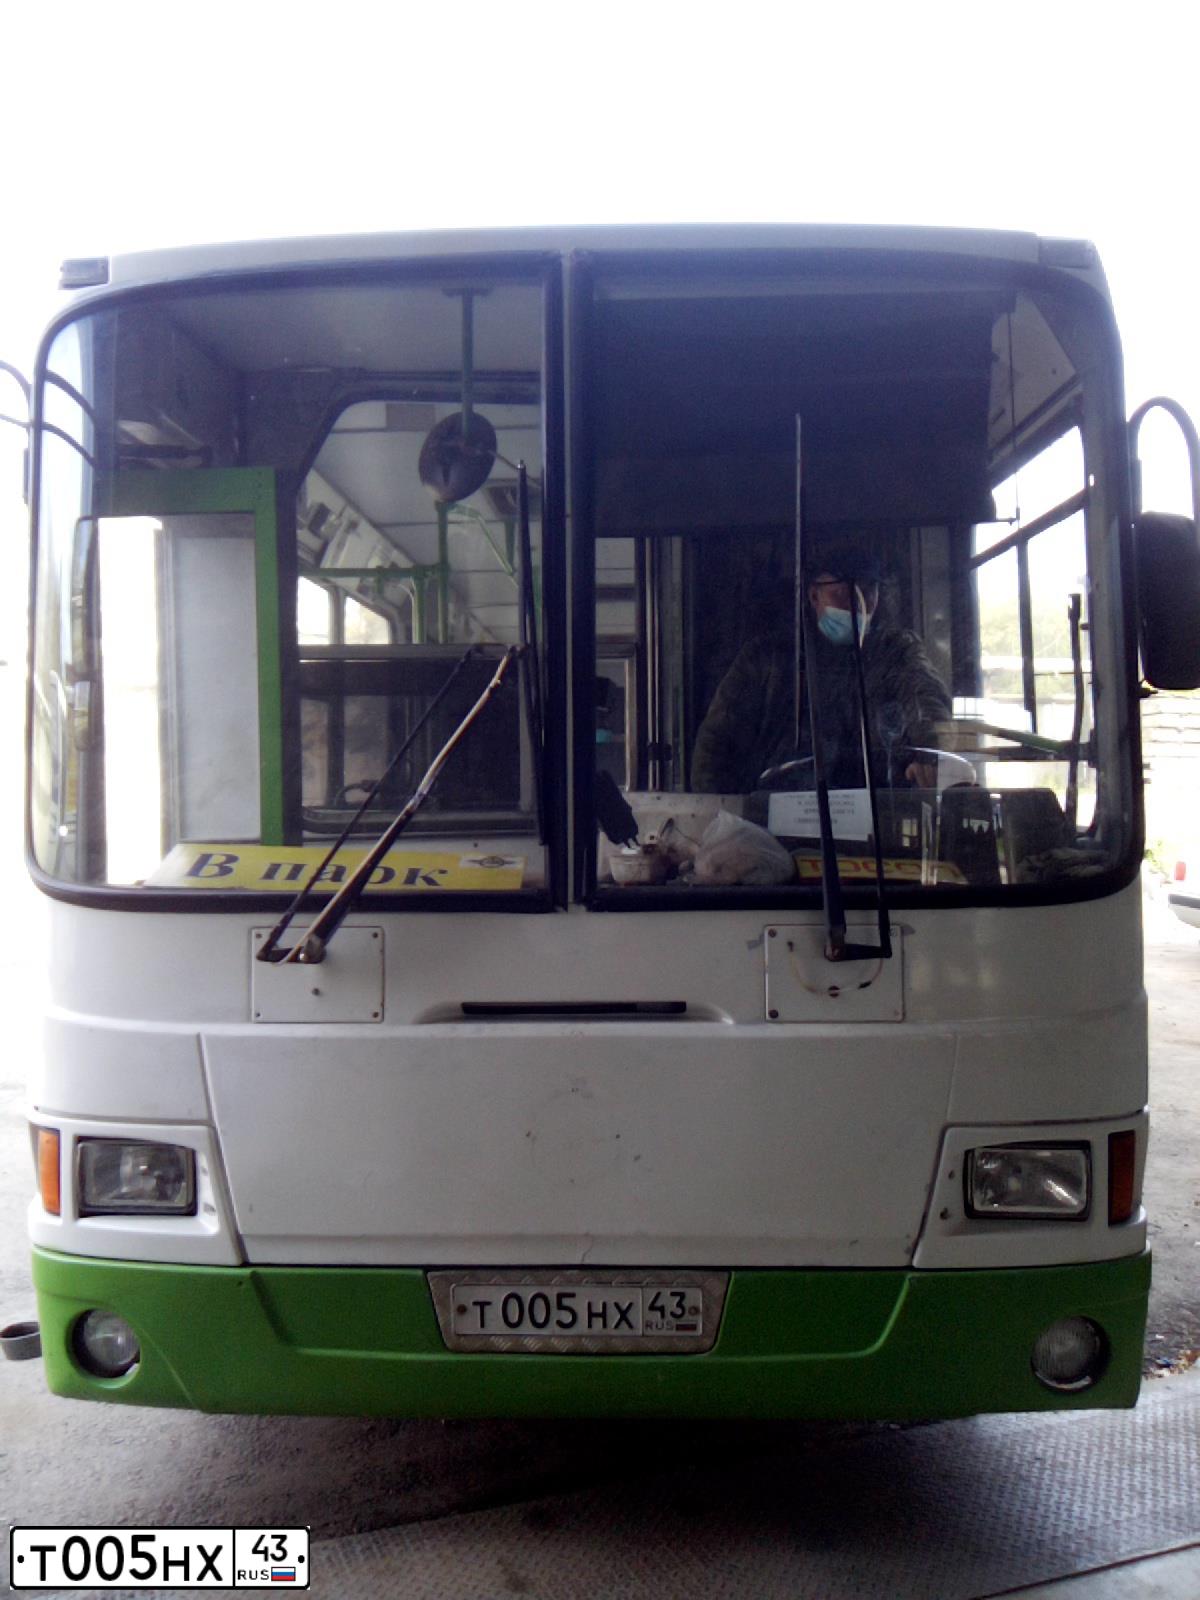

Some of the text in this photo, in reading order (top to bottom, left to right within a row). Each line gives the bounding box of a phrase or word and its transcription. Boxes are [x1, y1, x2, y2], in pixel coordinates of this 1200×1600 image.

[186, 852, 240, 878] В
[472, 1291, 687, 1329] Т005НХ 43
[645, 1320, 675, 1330] RUS
